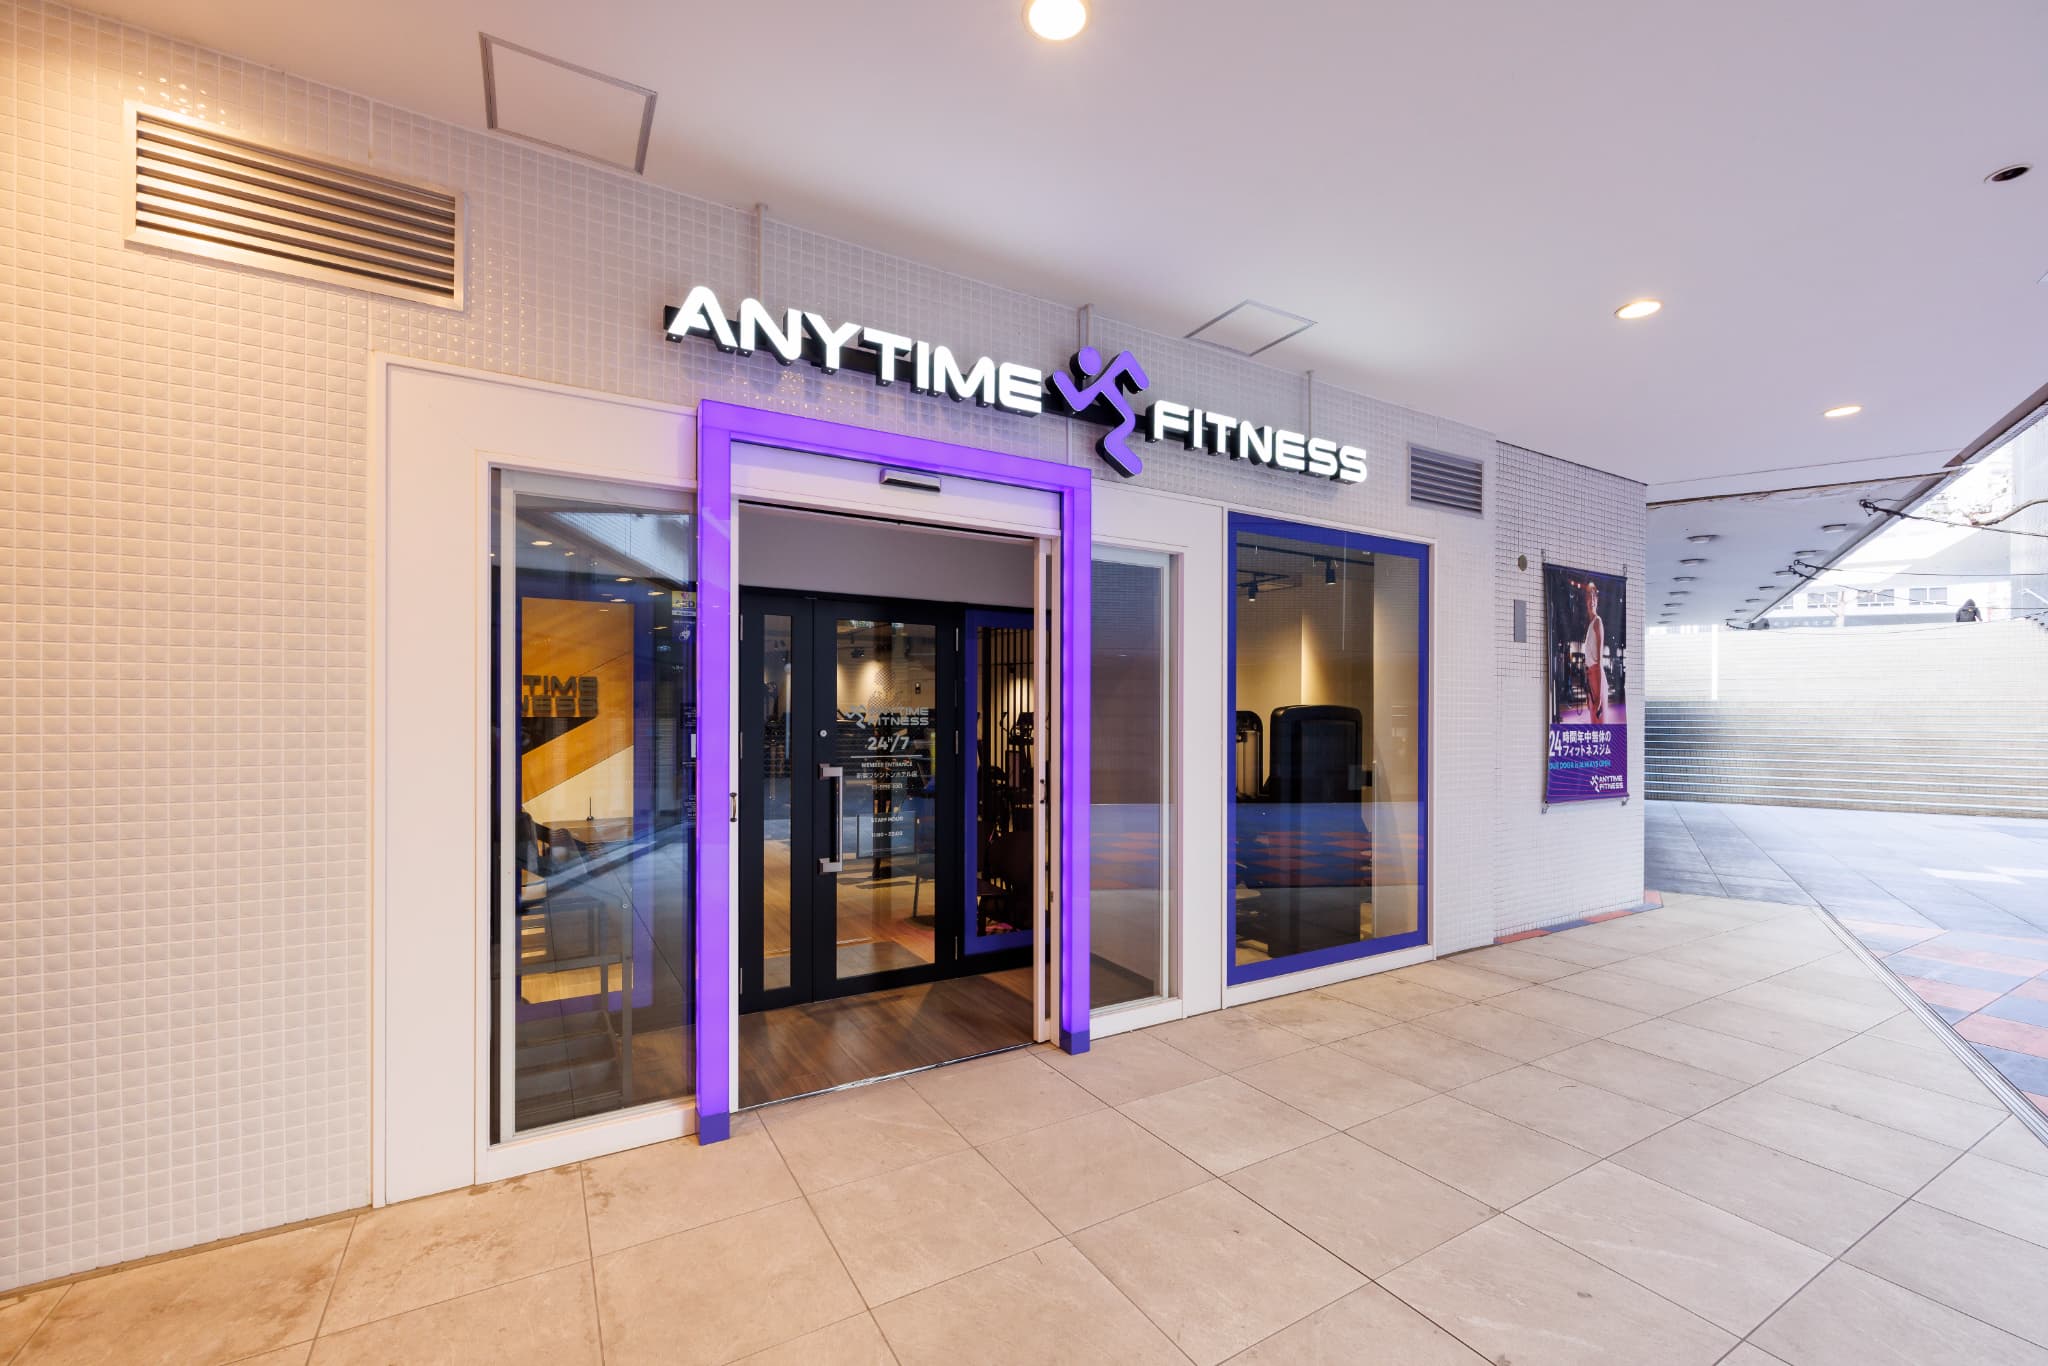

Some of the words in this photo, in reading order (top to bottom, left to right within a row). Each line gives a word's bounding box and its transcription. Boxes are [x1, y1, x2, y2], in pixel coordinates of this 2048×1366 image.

[666, 286, 1045, 415] ANYTIME
[1151, 400, 1368, 485] FITNESS
[867, 716, 929, 726] FITNESS
[1549, 729, 1562, 757] 24
[1562, 730, 1612, 744] 時間年中無休の
[1563, 744, 1612, 757] フィットネスジム
[1599, 775, 1624, 783] ANYTIME
[1599, 782, 1624, 791] FITNESS
